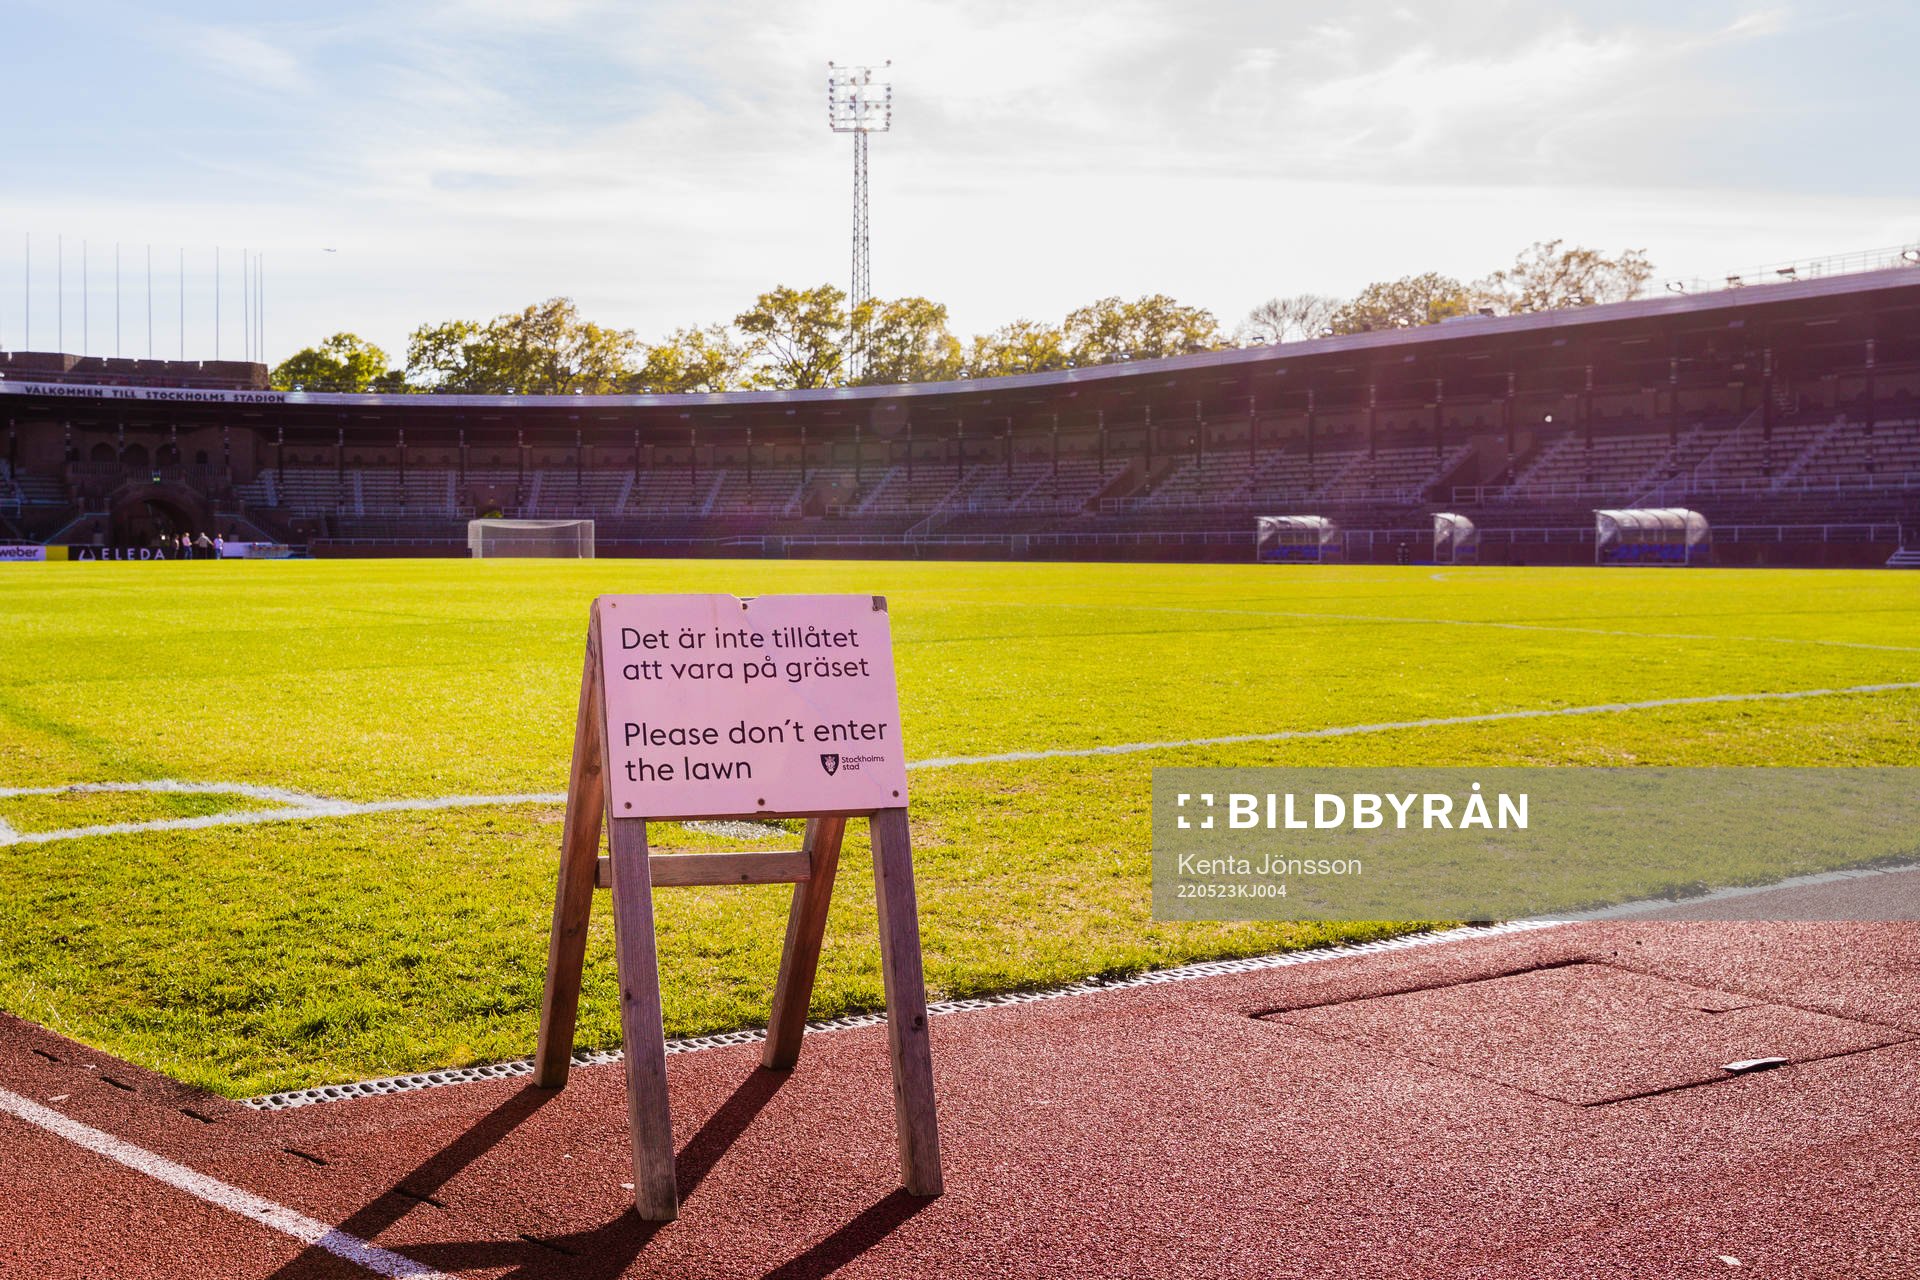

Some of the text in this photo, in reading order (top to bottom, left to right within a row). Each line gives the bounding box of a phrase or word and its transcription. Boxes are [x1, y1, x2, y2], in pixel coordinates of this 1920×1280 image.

[112, 389, 137, 398] TILL
[145, 391, 226, 401] STOCKHOLMS
[233, 394, 286, 403] STADION
[0, 547, 38, 558] weber
[102, 548, 165, 560] ELEDA
[621, 625, 859, 650] Det är inte tillåtet
[623, 656, 870, 684] att vara på gräset
[624, 722, 719, 747] Please
[813, 720, 887, 742] enter
[841, 755, 885, 764] Stockholms
[625, 756, 752, 781] the lawn
[842, 763, 860, 771] stad
